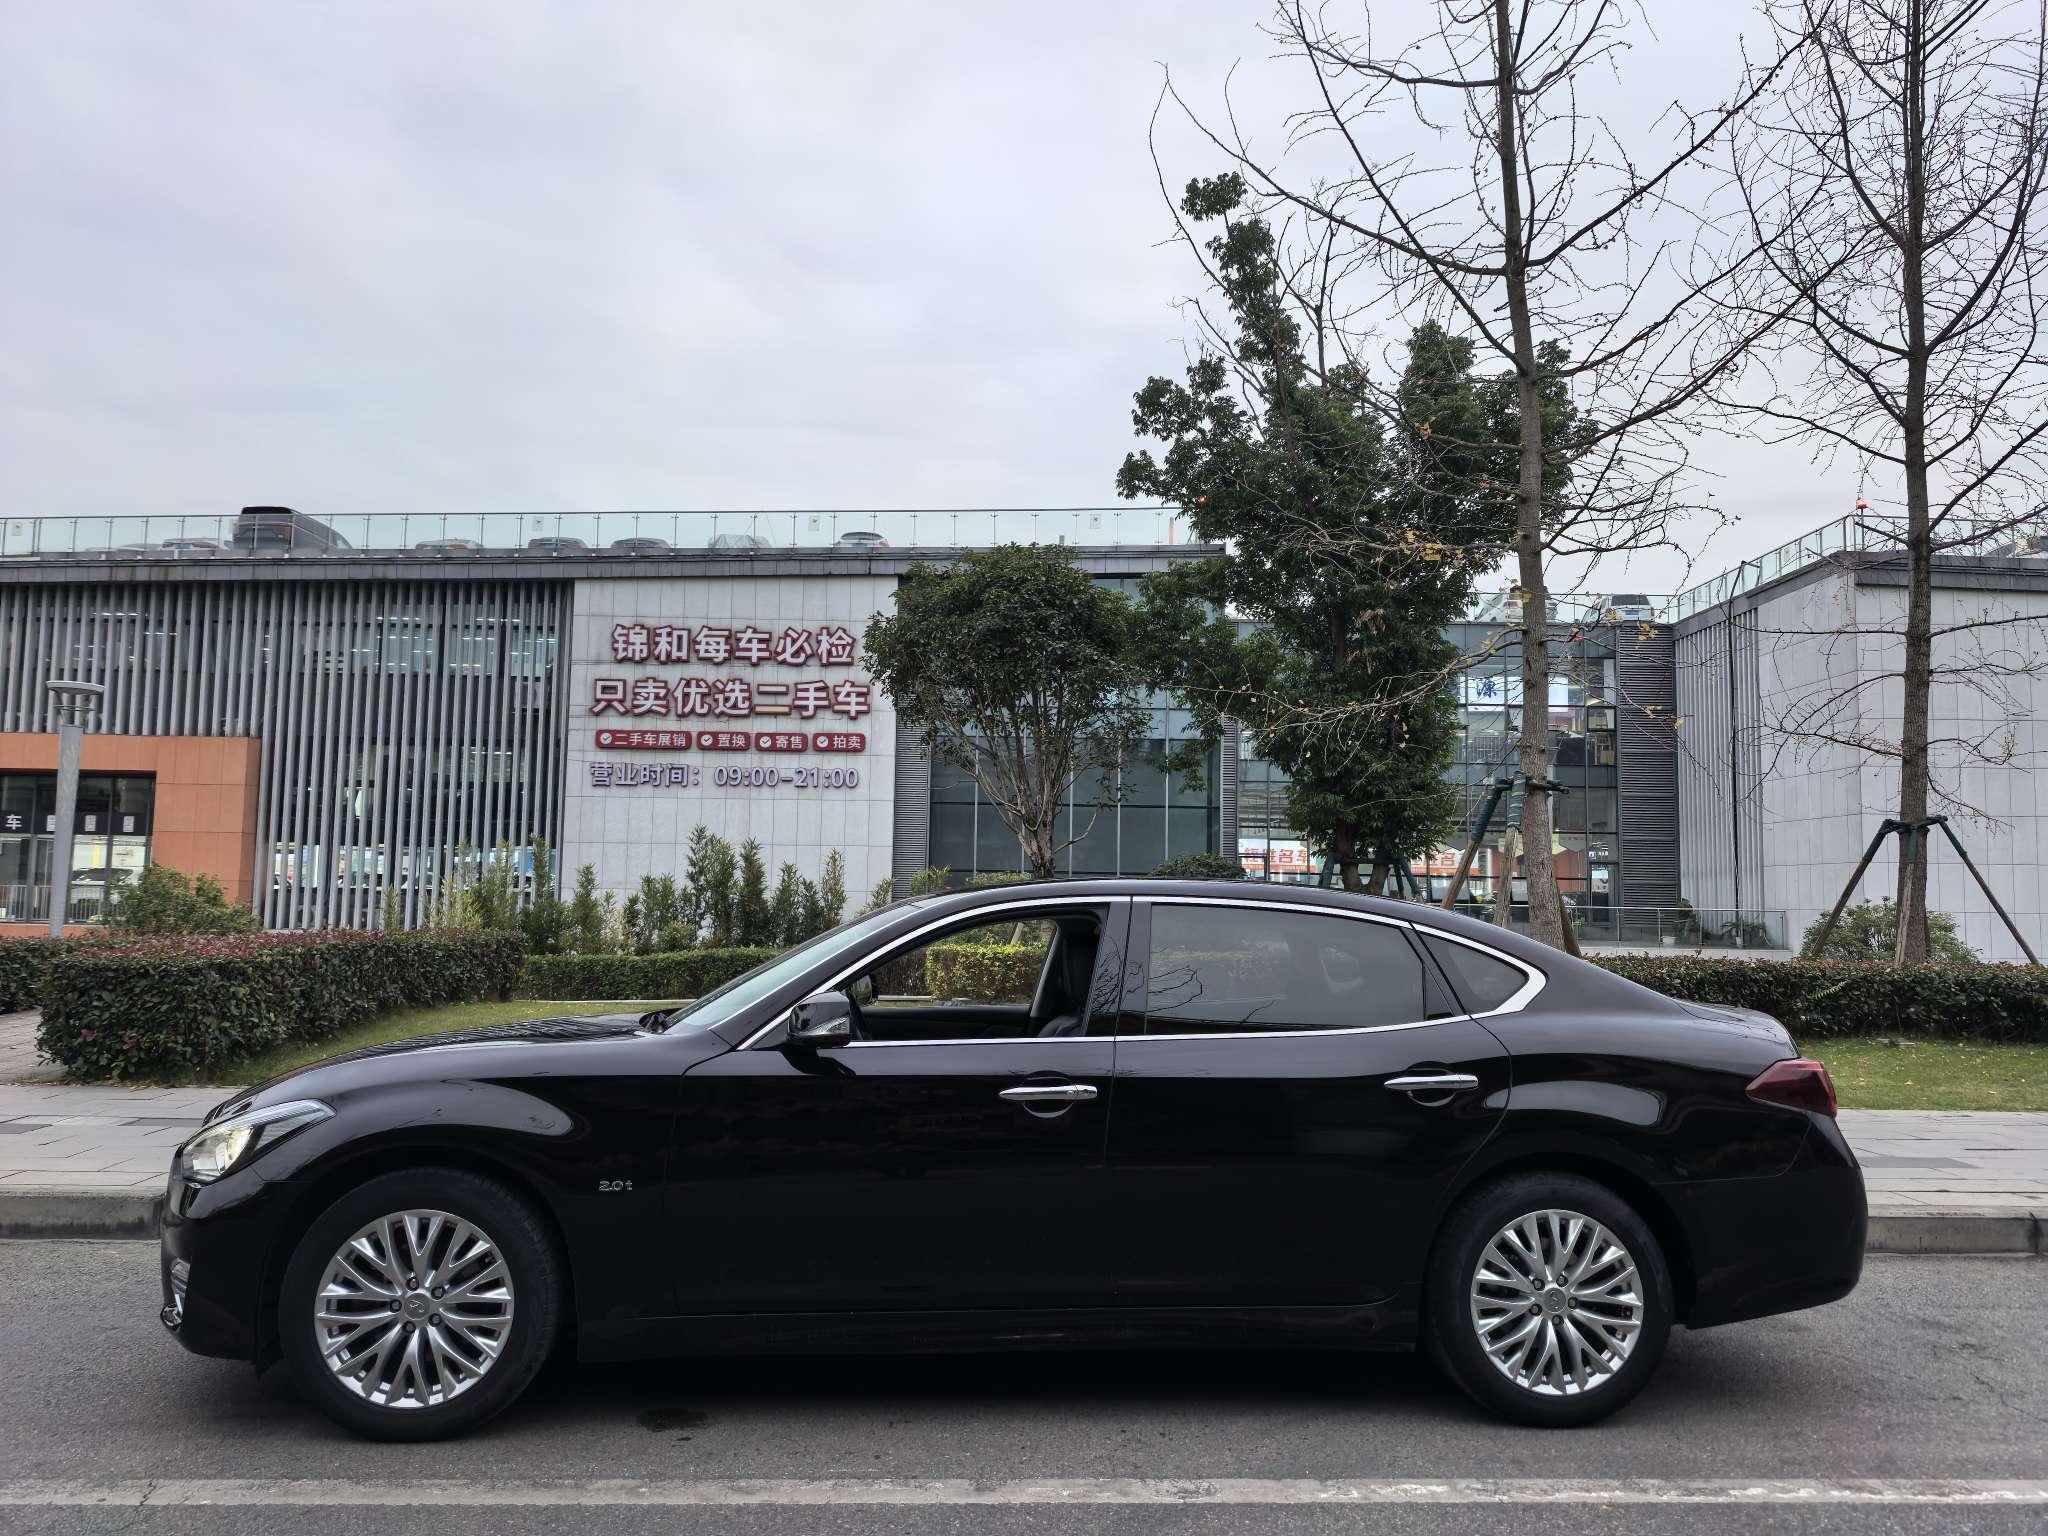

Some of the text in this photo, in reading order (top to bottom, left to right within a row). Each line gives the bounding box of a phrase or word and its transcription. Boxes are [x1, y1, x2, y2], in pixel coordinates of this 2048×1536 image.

[612, 624, 855, 666] 锦和每车必检
[592, 677, 871, 720] 只卖优选二手车
[615, 732, 861, 749] 二手车展销 置换 寄售 拍卖
[714, 766, 859, 788] 09:00-21:00
[5, 814, 22, 830] 车
[599, 1180, 633, 1191] 2.0t
